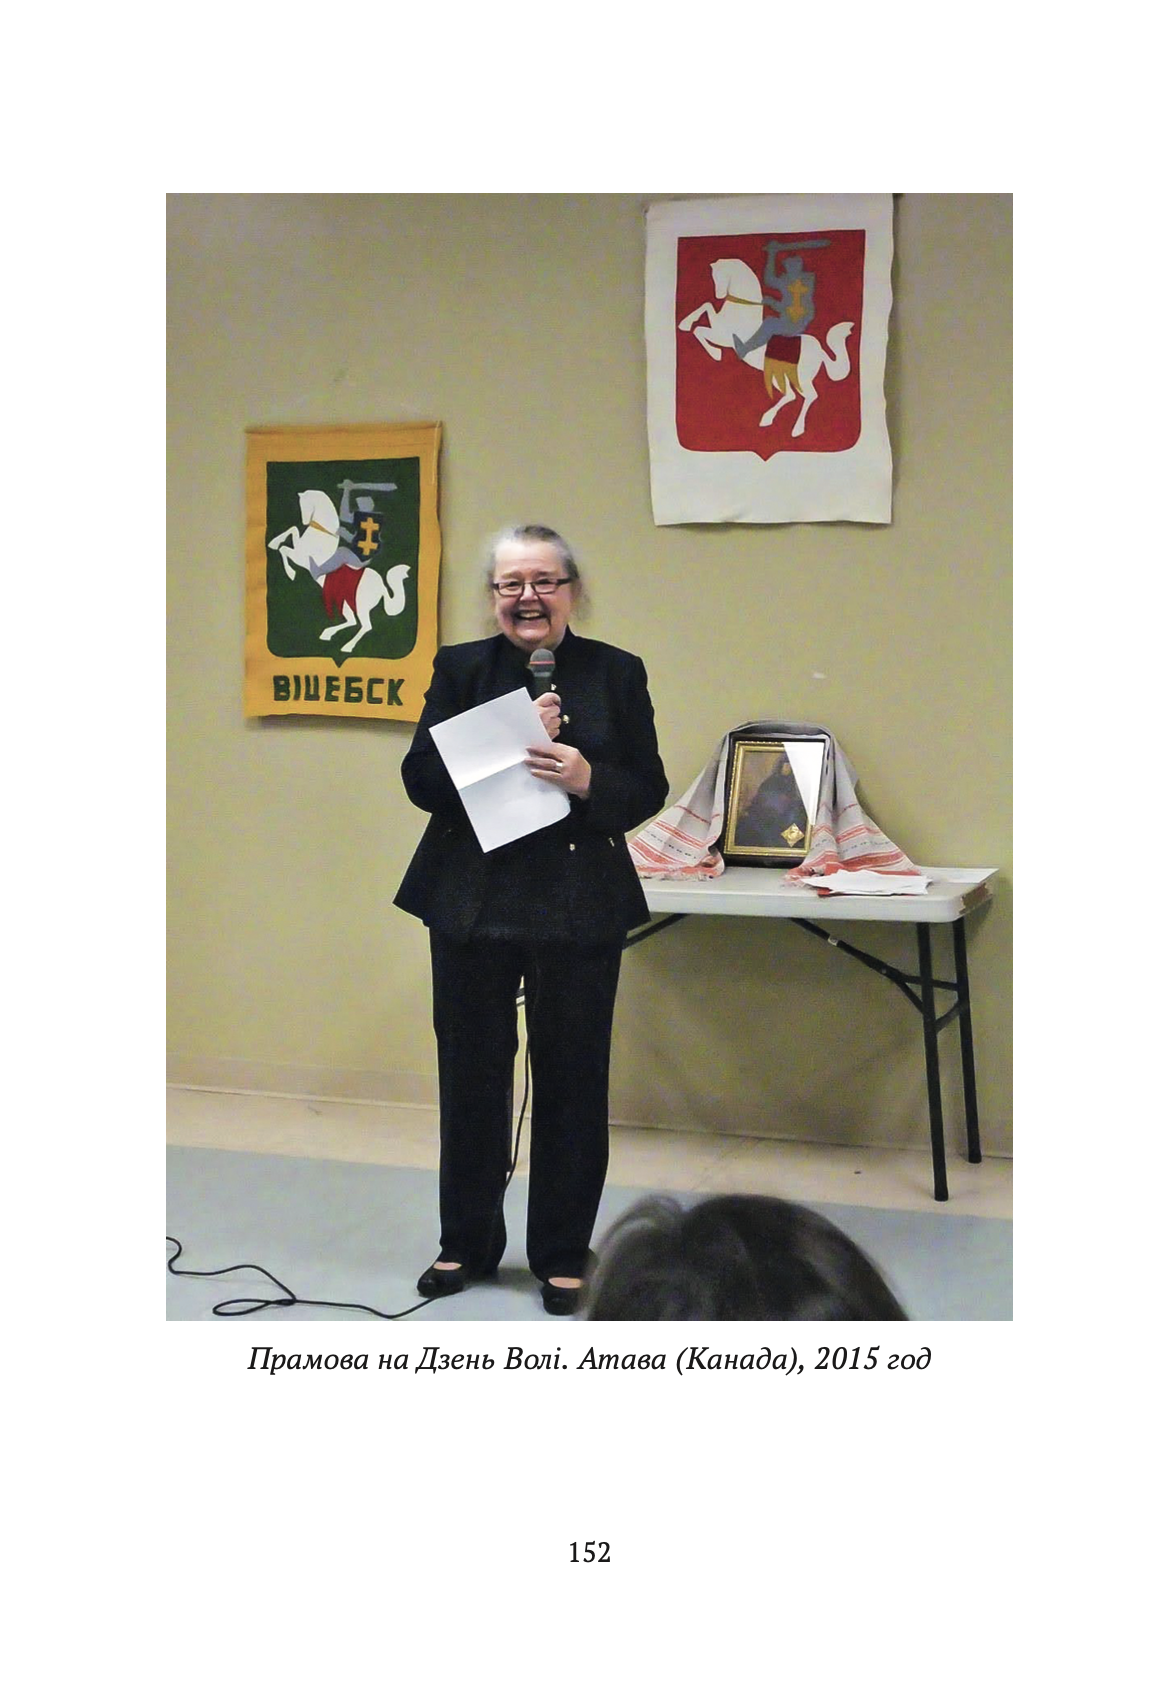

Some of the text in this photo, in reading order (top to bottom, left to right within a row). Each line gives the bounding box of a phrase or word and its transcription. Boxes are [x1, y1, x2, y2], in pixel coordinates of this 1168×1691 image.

[272, 674, 406, 707] ВІЦЕБСК
[246, 1345, 932, 1376] Прамова на Дзень Волі. Атава (Канада), 2015 год
[569, 1540, 611, 1563] 152
